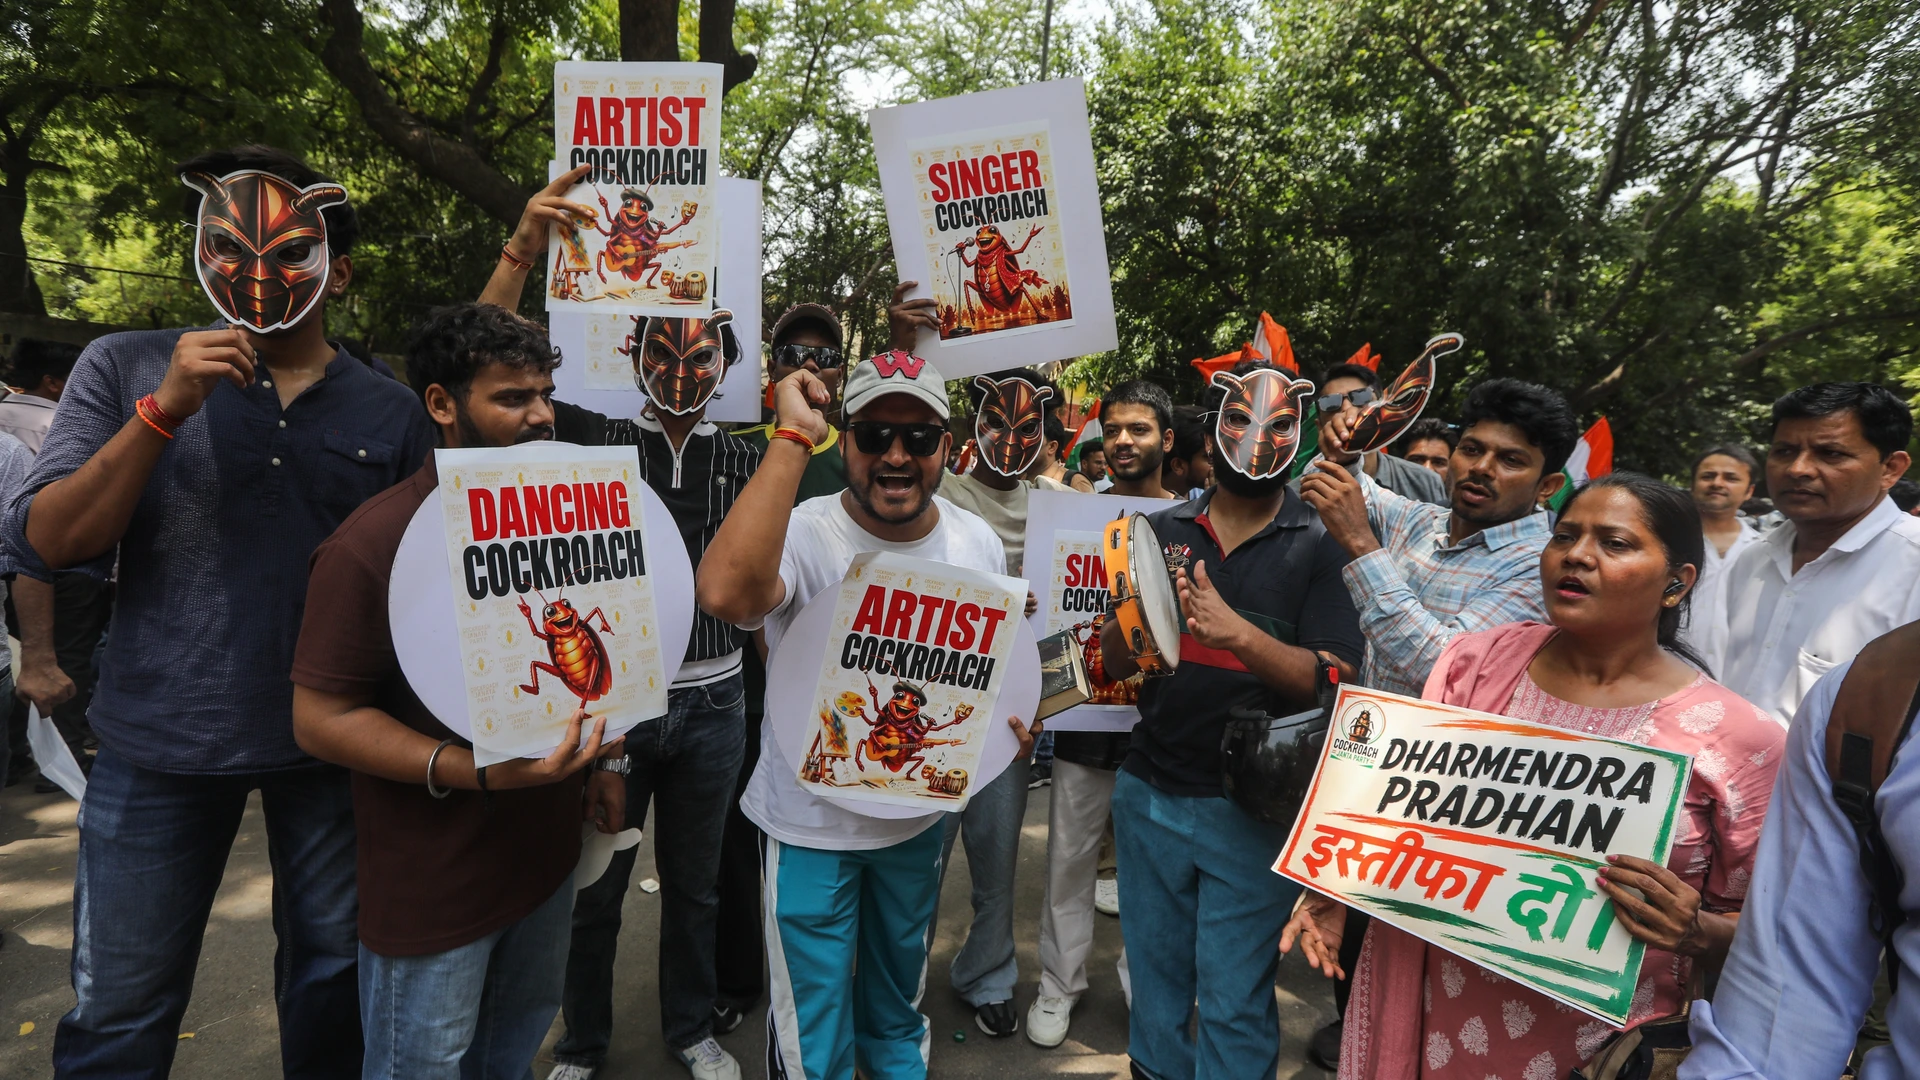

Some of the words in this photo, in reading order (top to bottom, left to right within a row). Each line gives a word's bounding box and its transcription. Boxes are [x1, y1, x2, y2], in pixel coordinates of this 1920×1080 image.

[573, 96, 706, 147] ARTIST
[570, 147, 707, 186] COCKROACH
[928, 149, 1043, 203] SINGER
[934, 188, 1049, 232] COCKROACH
[870, 348, 926, 380] W
[467, 481, 630, 541] DANCING
[463, 530, 646, 600] COCKROACH
[1064, 553, 1109, 588] SIN
[852, 584, 1007, 655] ARTIST
[841, 633, 996, 691] COCKROACH
[1334, 738, 1379, 759] COCKROACH
[1336, 750, 1352, 760] JANTA
[1353, 754, 1370, 764] PARTY
[1379, 738, 1657, 804] DHARMENDRA
[1376, 776, 1626, 854] PRADHAN
[1302, 824, 1507, 913] इस्तीफा
